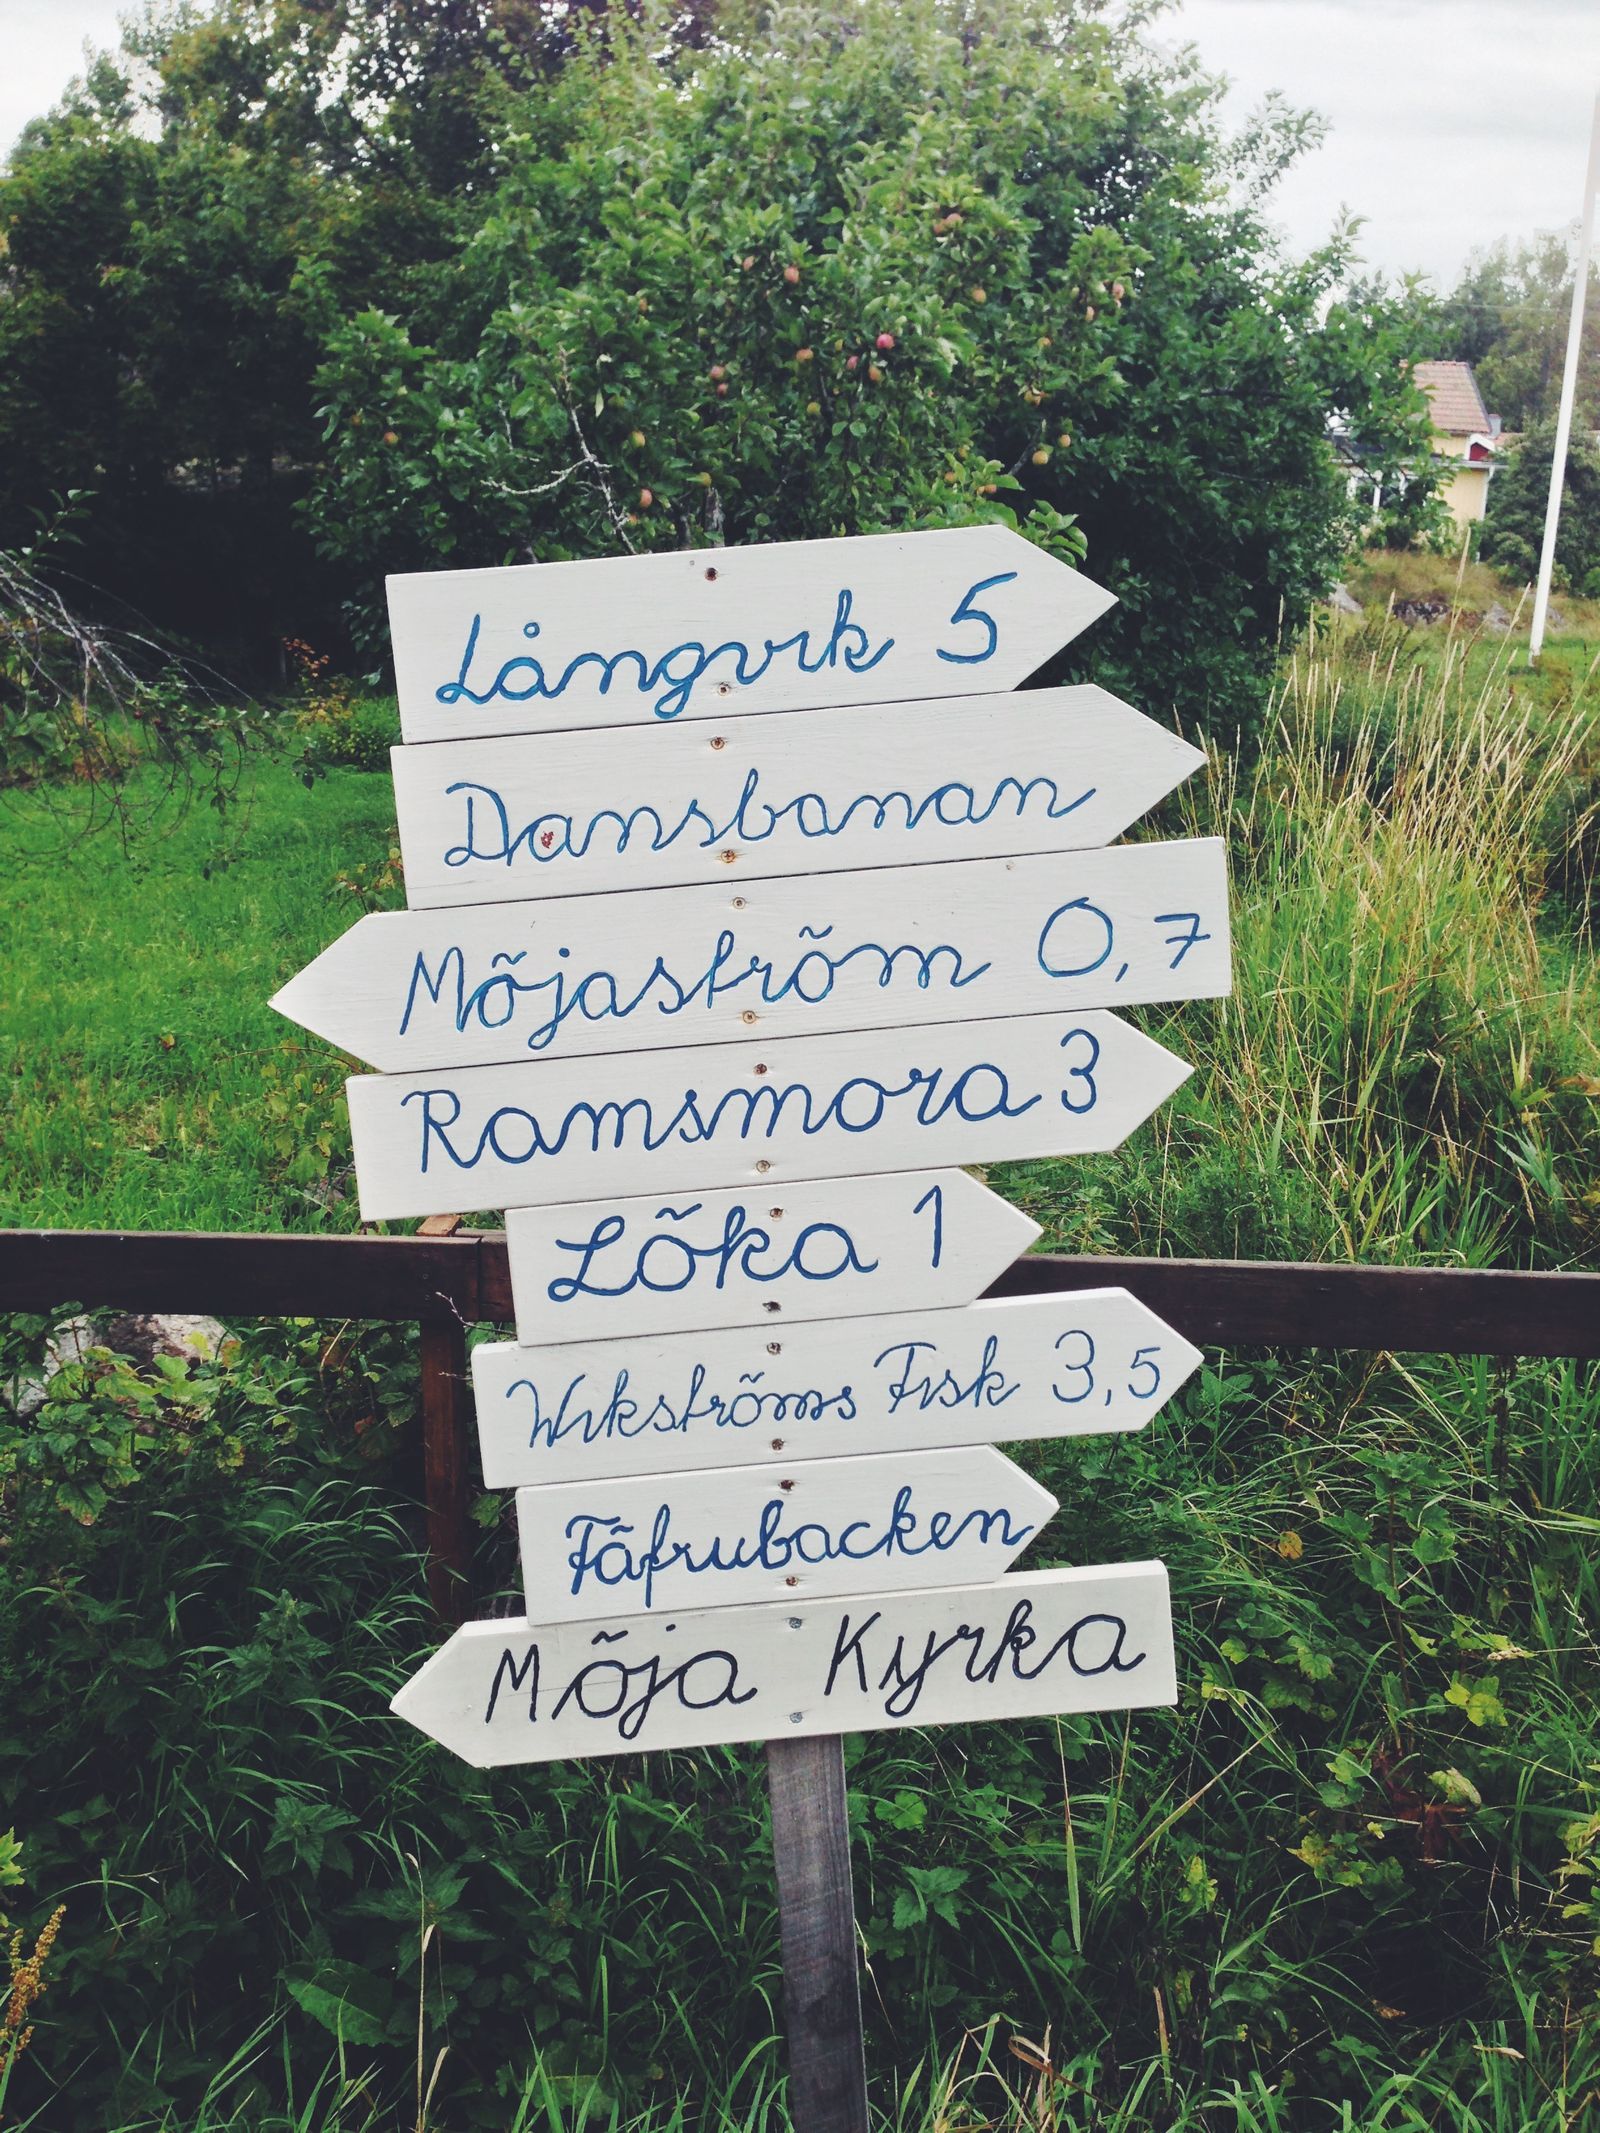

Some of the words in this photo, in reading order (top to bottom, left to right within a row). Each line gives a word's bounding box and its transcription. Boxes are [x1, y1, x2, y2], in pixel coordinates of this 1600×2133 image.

[435, 590, 895, 719] Långvik
[937, 572, 1017, 664] 5
[444, 768, 1096, 867] Dansbanan
[400, 1061, 1043, 1173] Ramsmora
[1061, 1029, 1099, 1114] 3
[914, 1185, 942, 1268] 1
[874, 1335, 1020, 1413] Fisk
[1052, 1329, 1162, 1408] 3,5
[824, 1599, 1147, 1717] Kyrka
